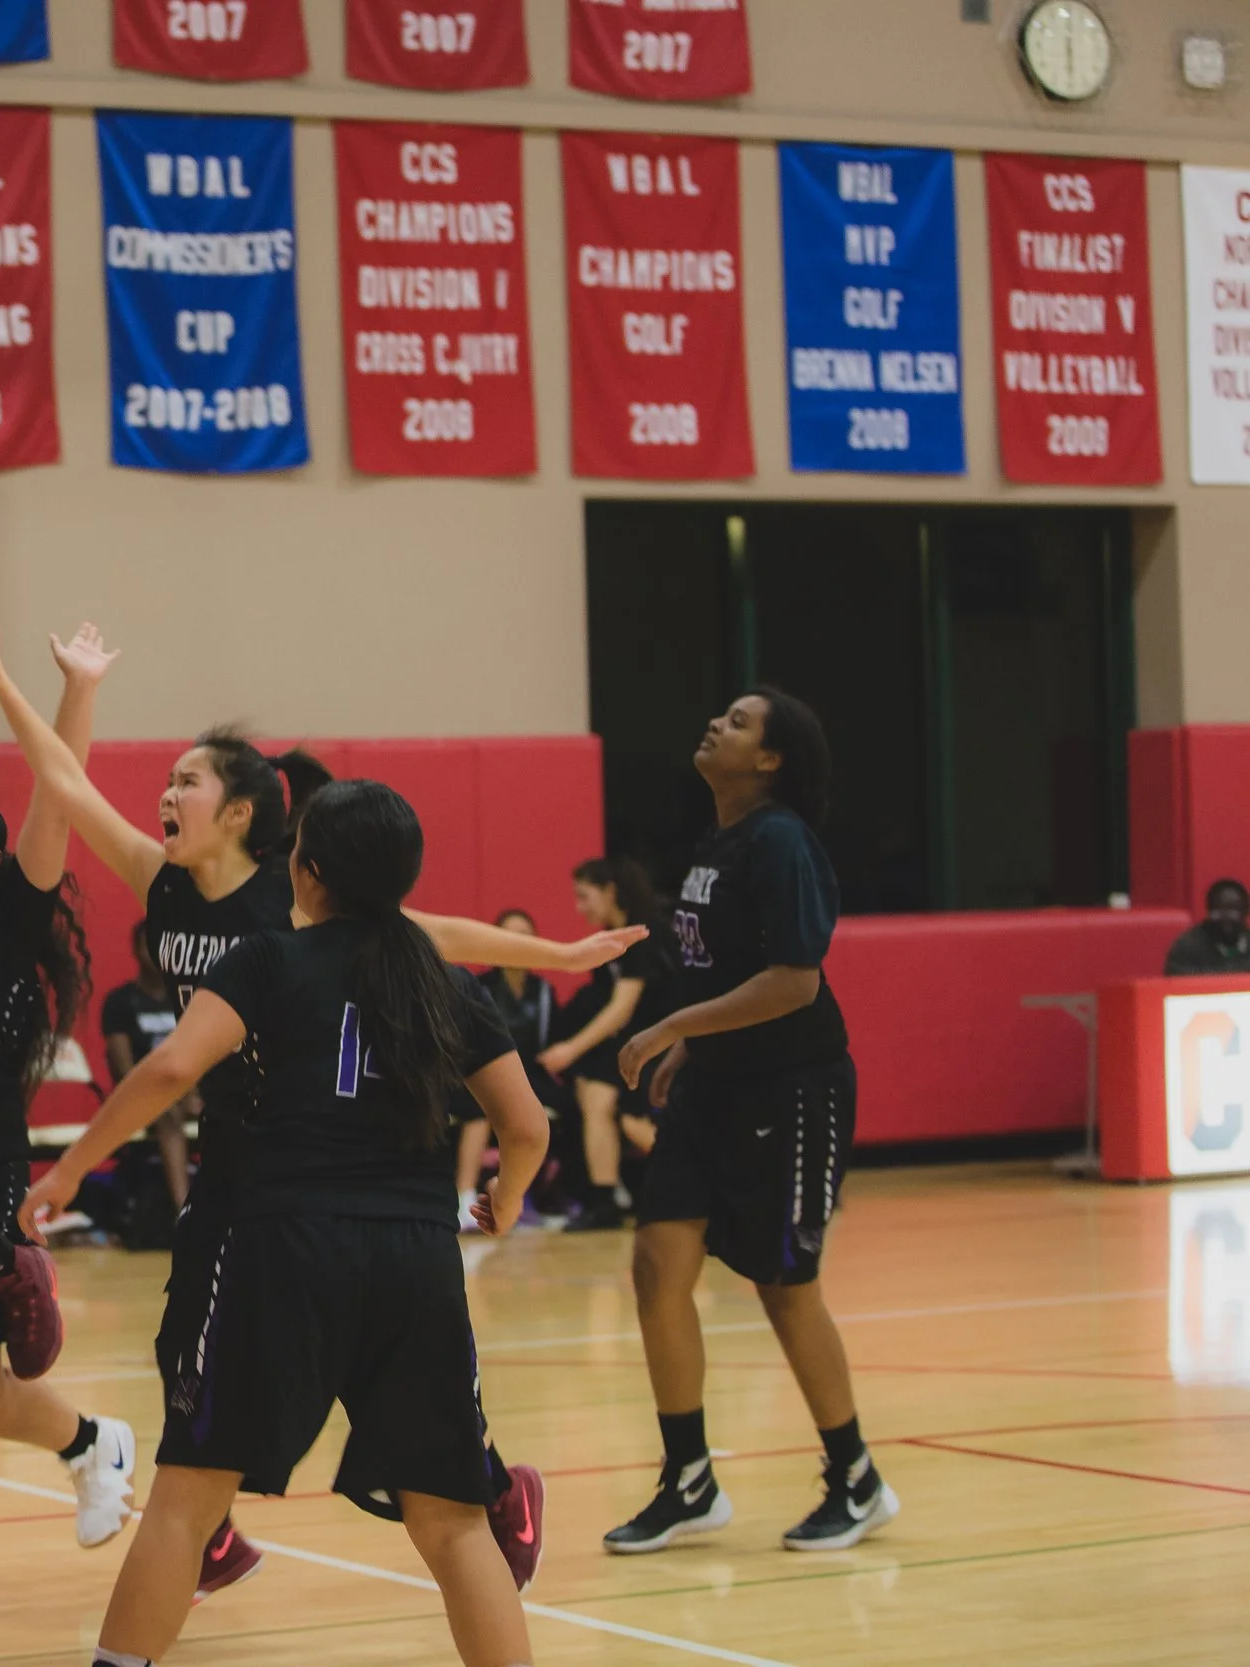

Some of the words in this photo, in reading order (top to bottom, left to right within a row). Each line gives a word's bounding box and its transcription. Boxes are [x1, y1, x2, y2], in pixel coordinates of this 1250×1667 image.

[168, 0, 247, 41] 2007
[402, 12, 475, 53] 2007
[623, 30, 692, 72] 2007
[147, 154, 251, 198] WBAL
[401, 142, 458, 184] CCS
[607, 154, 700, 196] WBAL
[1044, 173, 1095, 213] CCS
[356, 199, 514, 244] CHAMPIONS
[579, 245, 736, 291] CHAMPIONS
[1017, 230, 1125, 273] FINALIST
[358, 265, 481, 310] DIVISION
[844, 286, 904, 330] GOLF
[177, 310, 235, 354] CUP
[623, 312, 689, 356] GOLF
[1008, 290, 1106, 335] DIVISION
[1116, 295, 1135, 334] V
[356, 332, 425, 375] CROSS
[1003, 351, 1144, 395] VOLLEYBALL
[125, 384, 292, 432] 2007-2008
